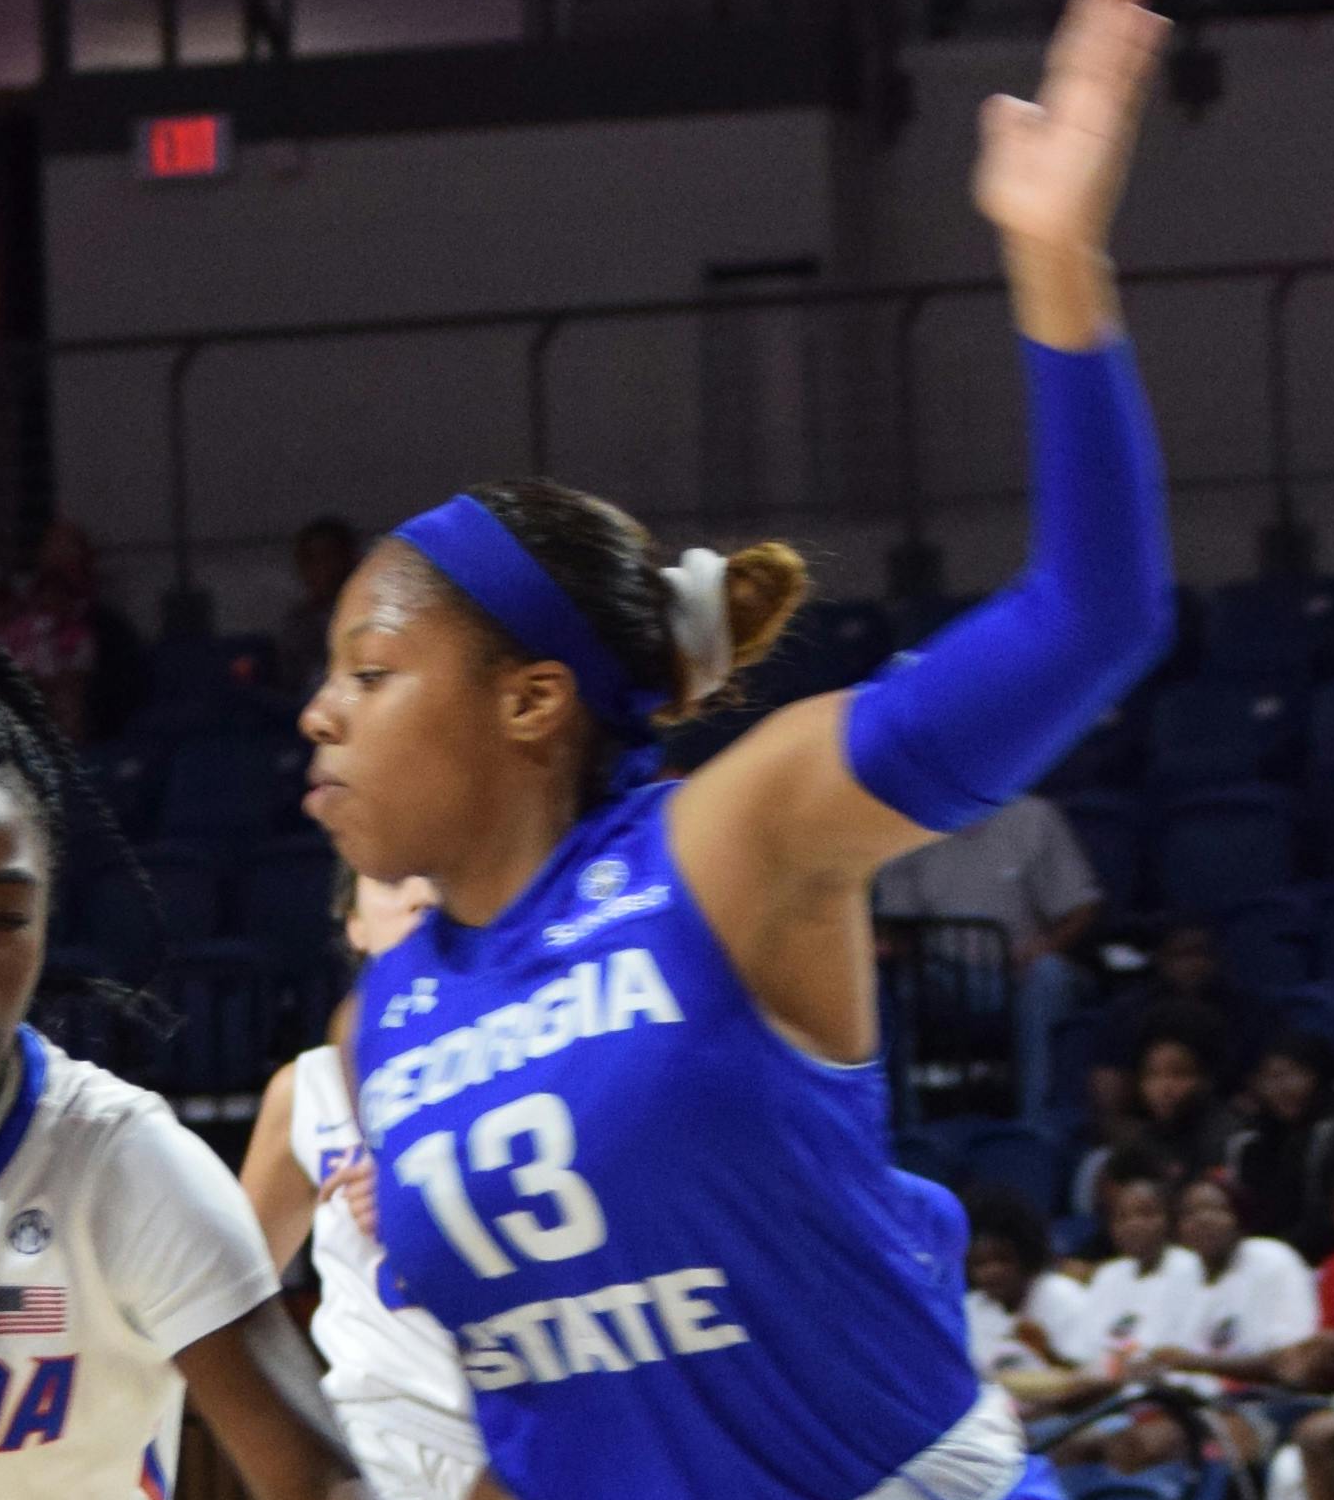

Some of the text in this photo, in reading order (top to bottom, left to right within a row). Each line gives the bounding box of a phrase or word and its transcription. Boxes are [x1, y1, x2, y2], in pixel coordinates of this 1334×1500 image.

[359, 948, 684, 1145] GEORGIA
[394, 1092, 607, 1278] 13
[460, 1267, 750, 1391] STATE
